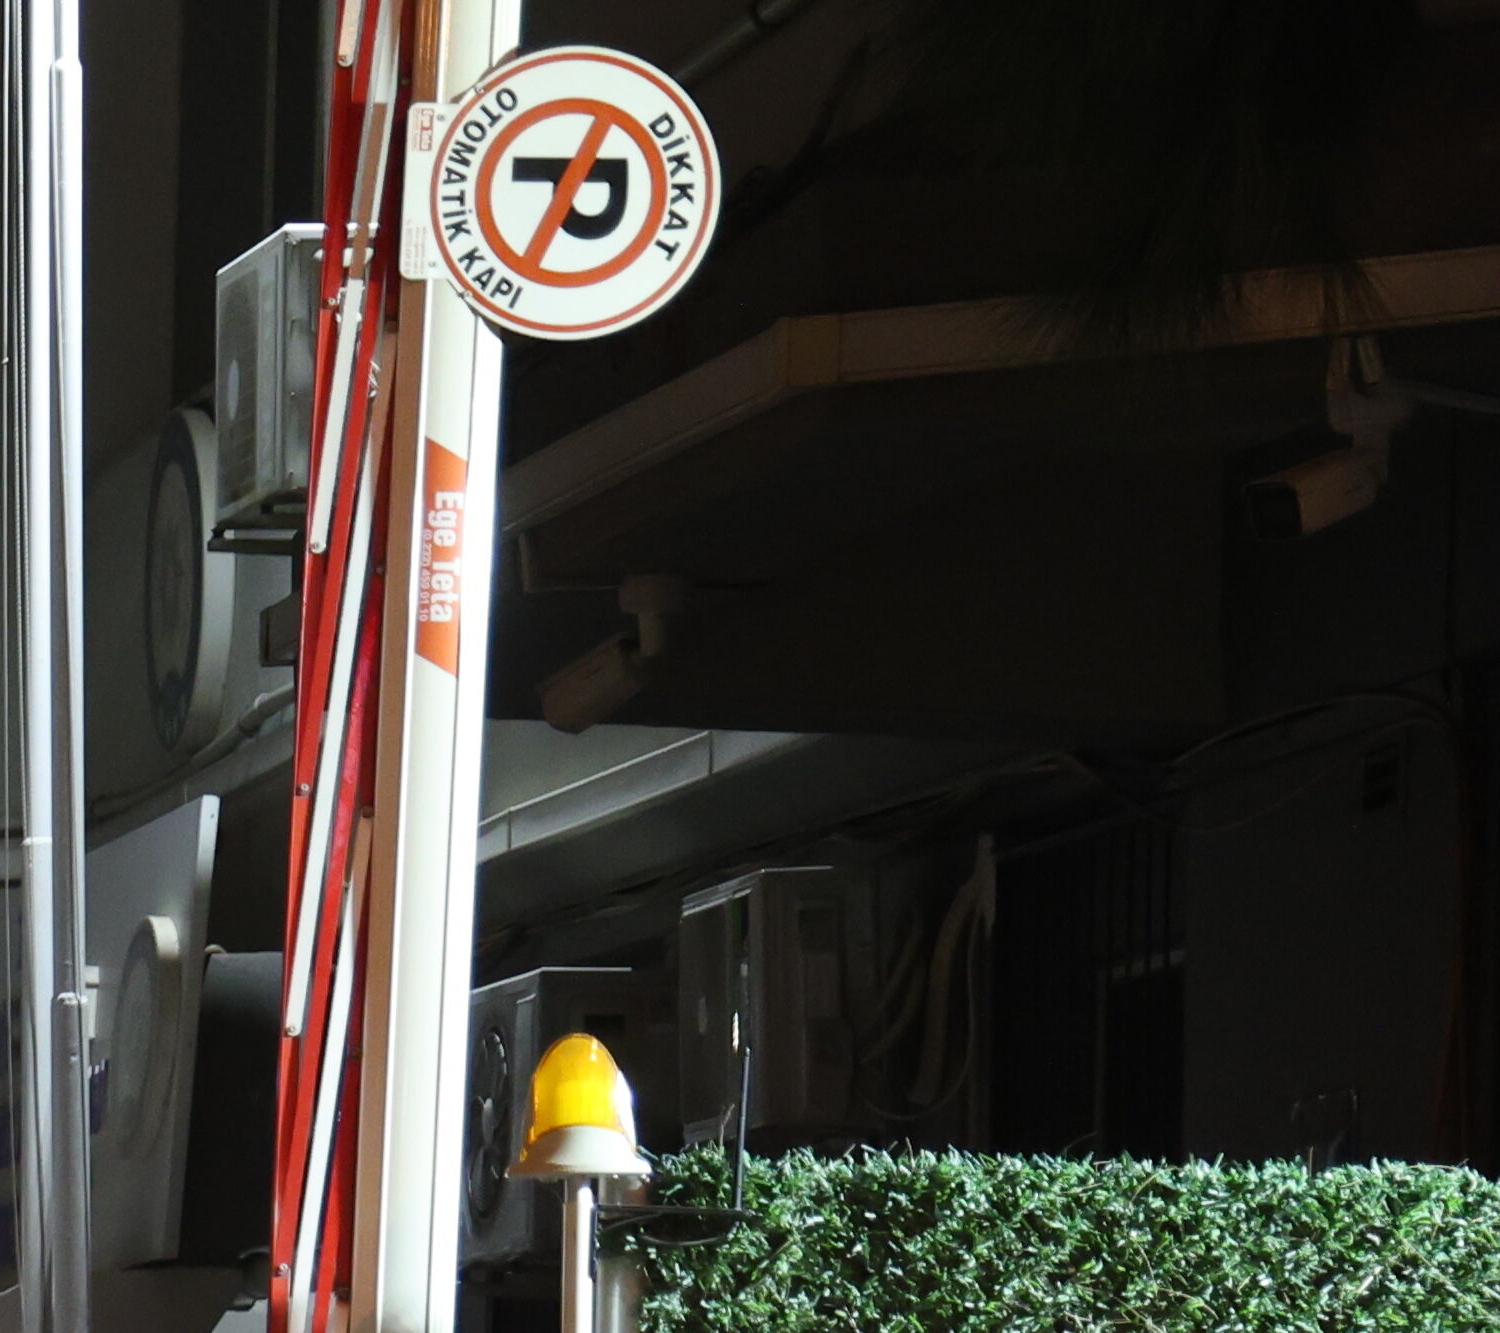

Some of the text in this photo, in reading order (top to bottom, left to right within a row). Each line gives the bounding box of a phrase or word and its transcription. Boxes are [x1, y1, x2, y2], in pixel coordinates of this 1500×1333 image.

[442, 87, 524, 309] OTOMATİK KAPI
[648, 112, 695, 263] DİKKAT
[428, 491, 464, 622] Ege Teta
